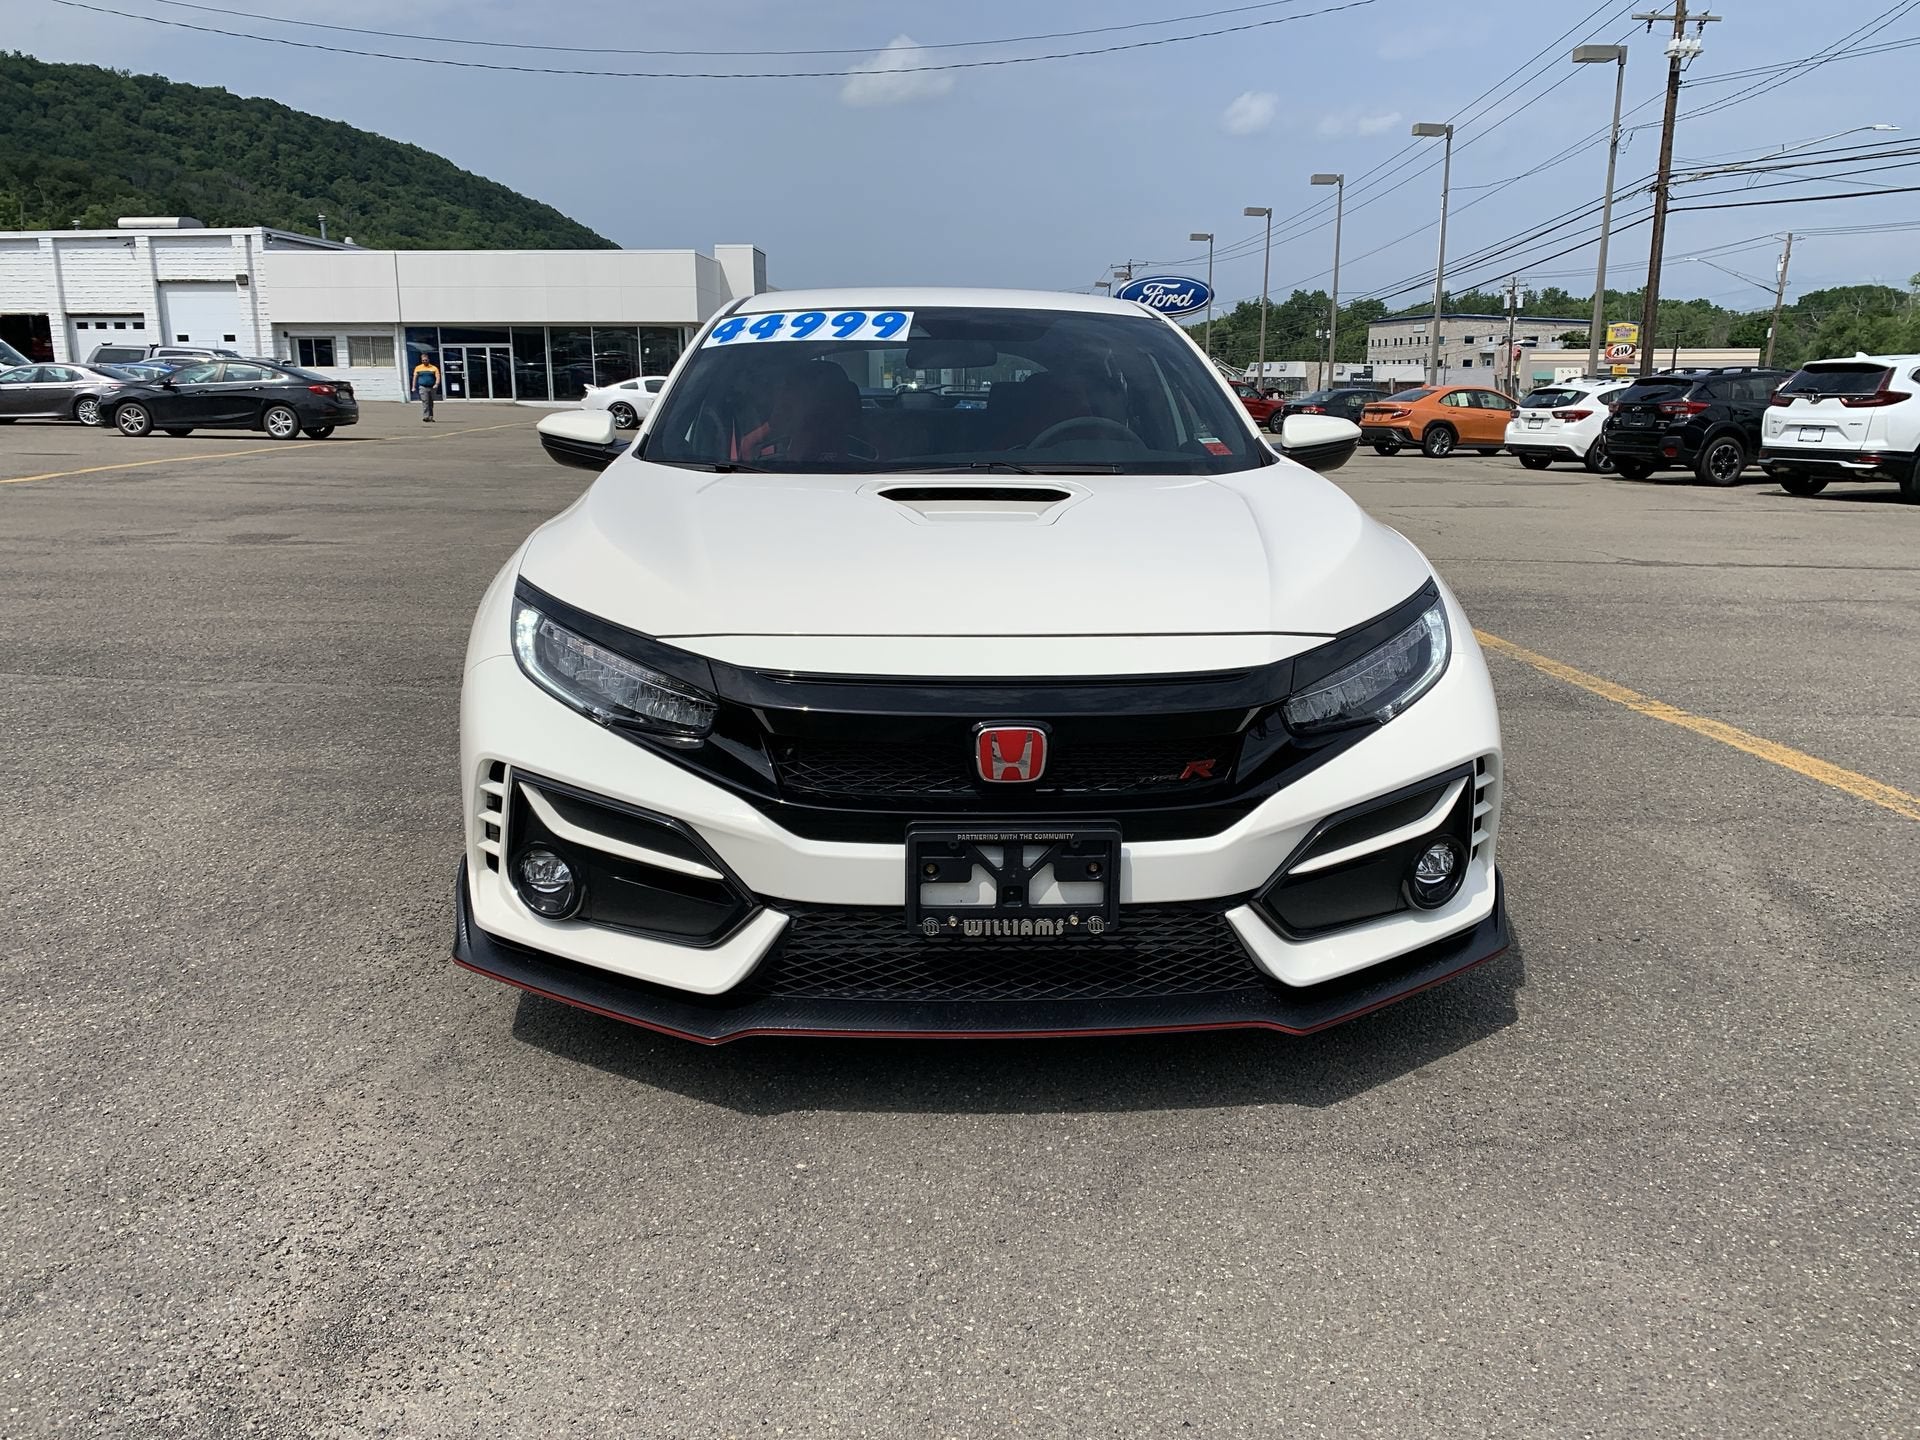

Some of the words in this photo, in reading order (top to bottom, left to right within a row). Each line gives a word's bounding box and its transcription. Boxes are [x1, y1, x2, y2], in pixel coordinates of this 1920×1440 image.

[1138, 283, 1195, 307] Ford
[711, 311, 910, 344] 44999
[1179, 759, 1216, 780] R
[957, 833, 999, 841] PARTNERING
[963, 918, 1064, 936] WILLIAMS
